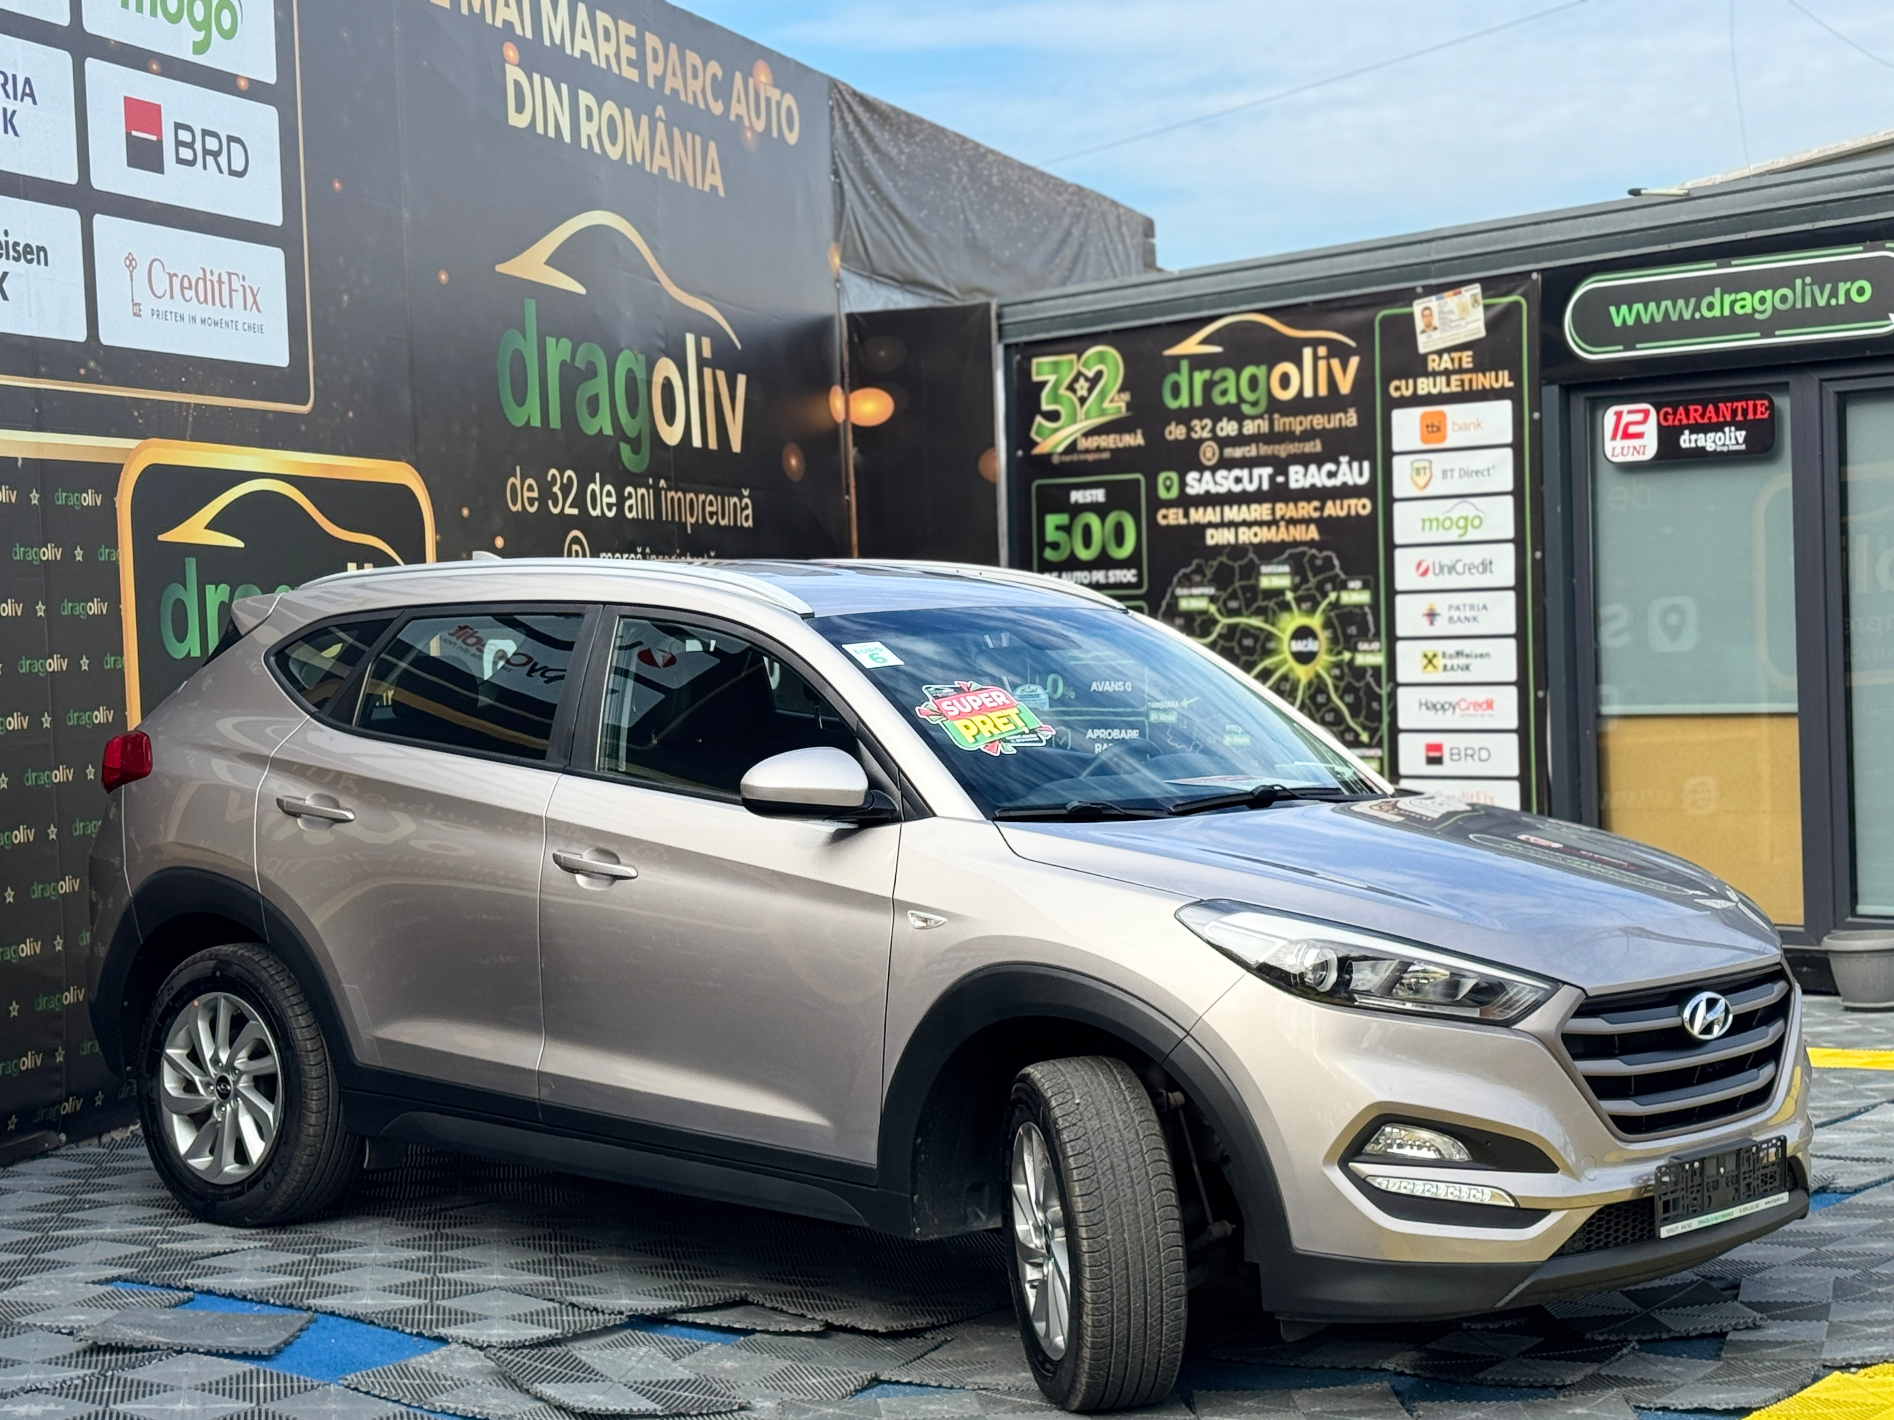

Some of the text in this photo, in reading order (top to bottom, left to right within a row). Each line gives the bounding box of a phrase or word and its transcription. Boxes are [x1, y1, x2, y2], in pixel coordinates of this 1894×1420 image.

[121, 0, 238, 55] ogo
[540, 0, 639, 83] MARE
[645, 31, 724, 116] PARC
[729, 70, 800, 146] AUTO
[505, 63, 725, 198] DIN ROMÂNIA
[173, 121, 250, 179] BRD
[147, 257, 262, 314] CreditFix
[1609, 276, 1872, 327] www.dragoliv.ro
[151, 308, 265, 335] PRIETEN IN MOMENTE CHEIE
[1427, 351, 1474, 372] RATE
[497, 298, 747, 473] dragoliv
[1030, 345, 1124, 443] 32
[1162, 347, 1361, 416] dragoliv
[1389, 370, 1514, 398] CU BULETINUL
[1164, 407, 1357, 441] de 32 de ani împreună
[1426, 418, 1483, 435] tbi bank
[1610, 399, 1770, 442] 12 GARANTIE
[1223, 445, 1258, 460] marcă
[1611, 445, 1647, 458] LUNI
[1680, 427, 1746, 452] dragoliv
[1185, 467, 1274, 496] SASCUT
[1288, 456, 1370, 489] BACĂU
[1442, 468, 1455, 480] BT
[1458, 466, 1493, 479] Direct
[54, 488, 102, 509] dragoliv
[506, 466, 753, 534] de 32 de ani împreună
[1069, 488, 1106, 504] PESTE
[1156, 497, 1372, 526] CEL MAI MARE PARC AUTO
[1043, 510, 1137, 562] 500
[1205, 522, 1320, 547] DIN ROMÂNIA
[1421, 514, 1483, 538] mogo
[12, 543, 62, 565] dragoliv
[1107, 568, 1138, 584] STOC
[1432, 558, 1494, 577] UniCredit
[61, 598, 108, 619] dragoliv
[1448, 603, 1489, 613] PATRIA
[1448, 615, 1480, 625] BANK
[853, 647, 883, 655] EURO
[868, 652, 888, 664] 6
[18, 655, 68, 676] dragoliv
[1442, 663, 1472, 673] BANK
[941, 690, 1011, 717] SUPER
[1419, 697, 1495, 715] HappyCredit
[66, 706, 114, 729] dragoliv
[1086, 729, 1139, 740] APROBARE
[1449, 746, 1491, 762] BRD
[24, 765, 74, 789] dragoliv
[31, 875, 80, 901] dragoliv
[35, 985, 85, 1012] dragoliv
[32, 1096, 84, 1122] dragoliv
